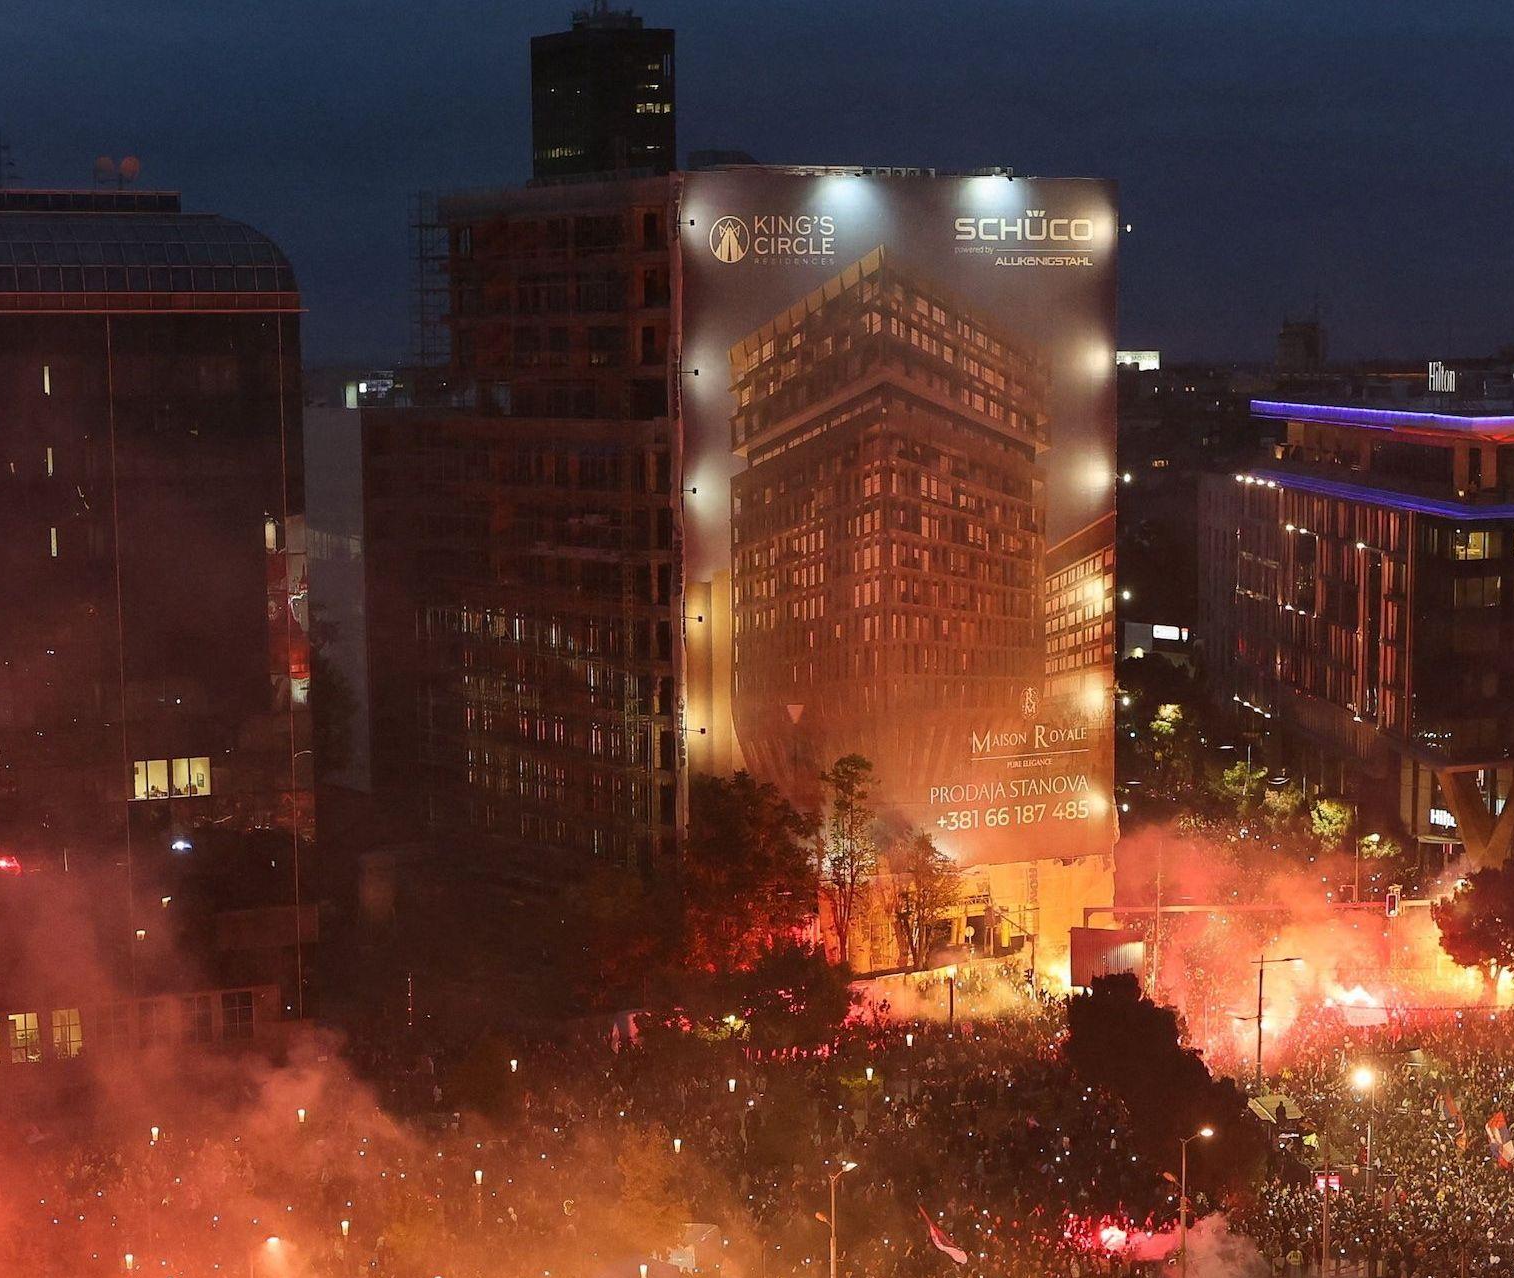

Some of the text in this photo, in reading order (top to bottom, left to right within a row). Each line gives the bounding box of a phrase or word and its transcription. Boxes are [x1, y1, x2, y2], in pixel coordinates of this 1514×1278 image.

[754, 215, 835, 235] KING'S
[954, 210, 1093, 241] SCHÜCO
[754, 237, 835, 255] CIRCLE
[954, 246, 994, 255] powered by
[1428, 361, 1456, 392] Hilton
[1007, 758, 1053, 768] PURE ELEGANCE
[930, 774, 1089, 805] PRODAJA STANOVA
[936, 800, 1089, 831] +381 66 187 485
